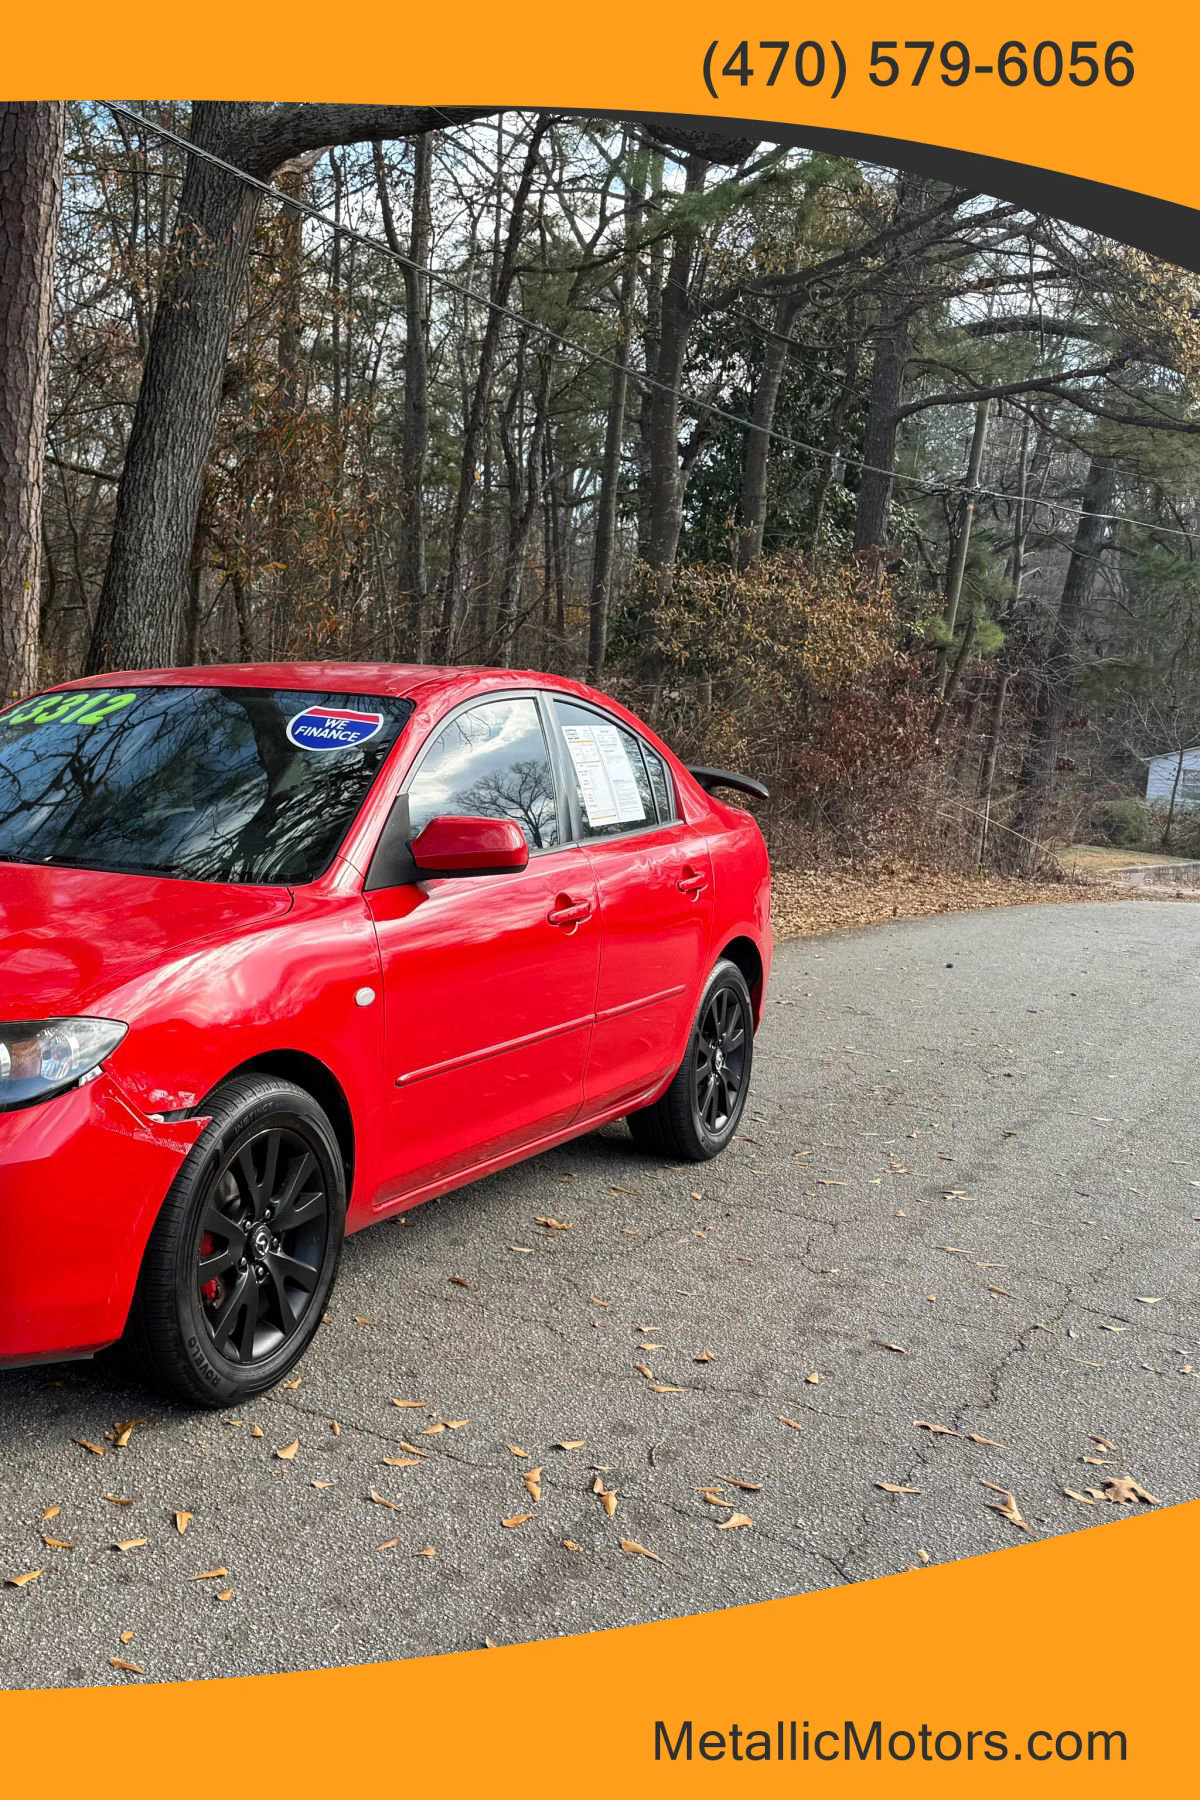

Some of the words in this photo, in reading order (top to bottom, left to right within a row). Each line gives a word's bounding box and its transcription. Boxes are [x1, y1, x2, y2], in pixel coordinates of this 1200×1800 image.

[294, 726, 360, 742] FINANCE
[325, 718, 349, 730] WE
[234, 1101, 274, 1135] INSTINCT
[188, 1336, 221, 1386] ROVELO
